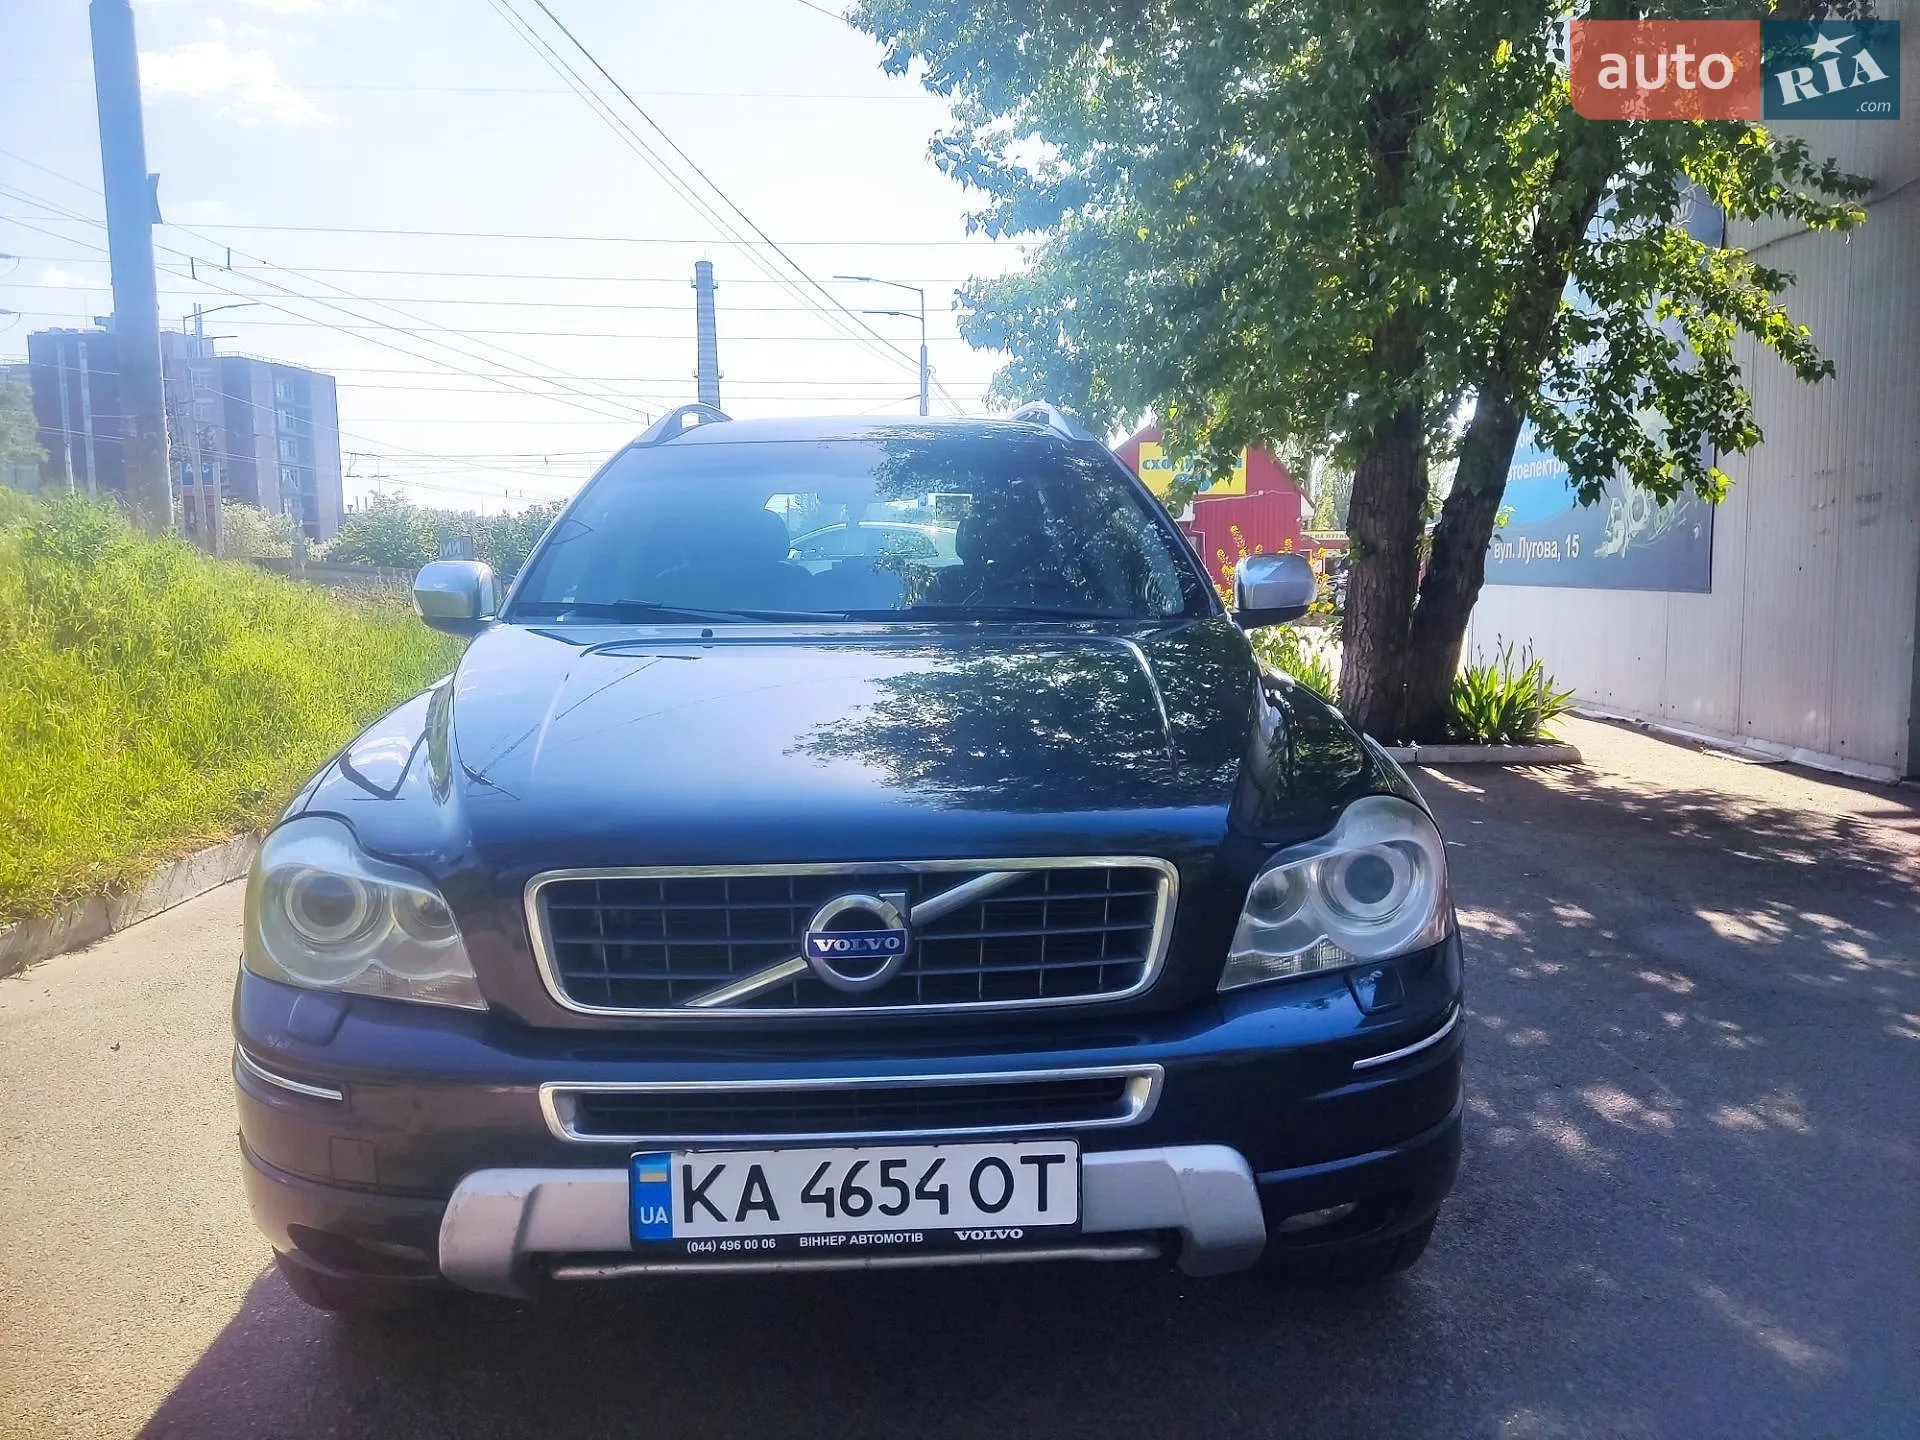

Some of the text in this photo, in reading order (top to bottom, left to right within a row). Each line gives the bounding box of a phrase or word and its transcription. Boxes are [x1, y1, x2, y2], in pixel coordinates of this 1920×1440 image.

[1506, 458, 1569, 481] втоелектри
[1494, 534, 1580, 564] вул. Лугова, 15
[813, 937, 900, 952] VOLVO
[682, 1154, 1066, 1223] KA 4654 OT
[640, 1206, 668, 1225] UA
[686, 1232, 924, 1254] (044) 496 00 06 ВІННЕР АВТОМОТІВ
[953, 1228, 1024, 1241] VOLVO
